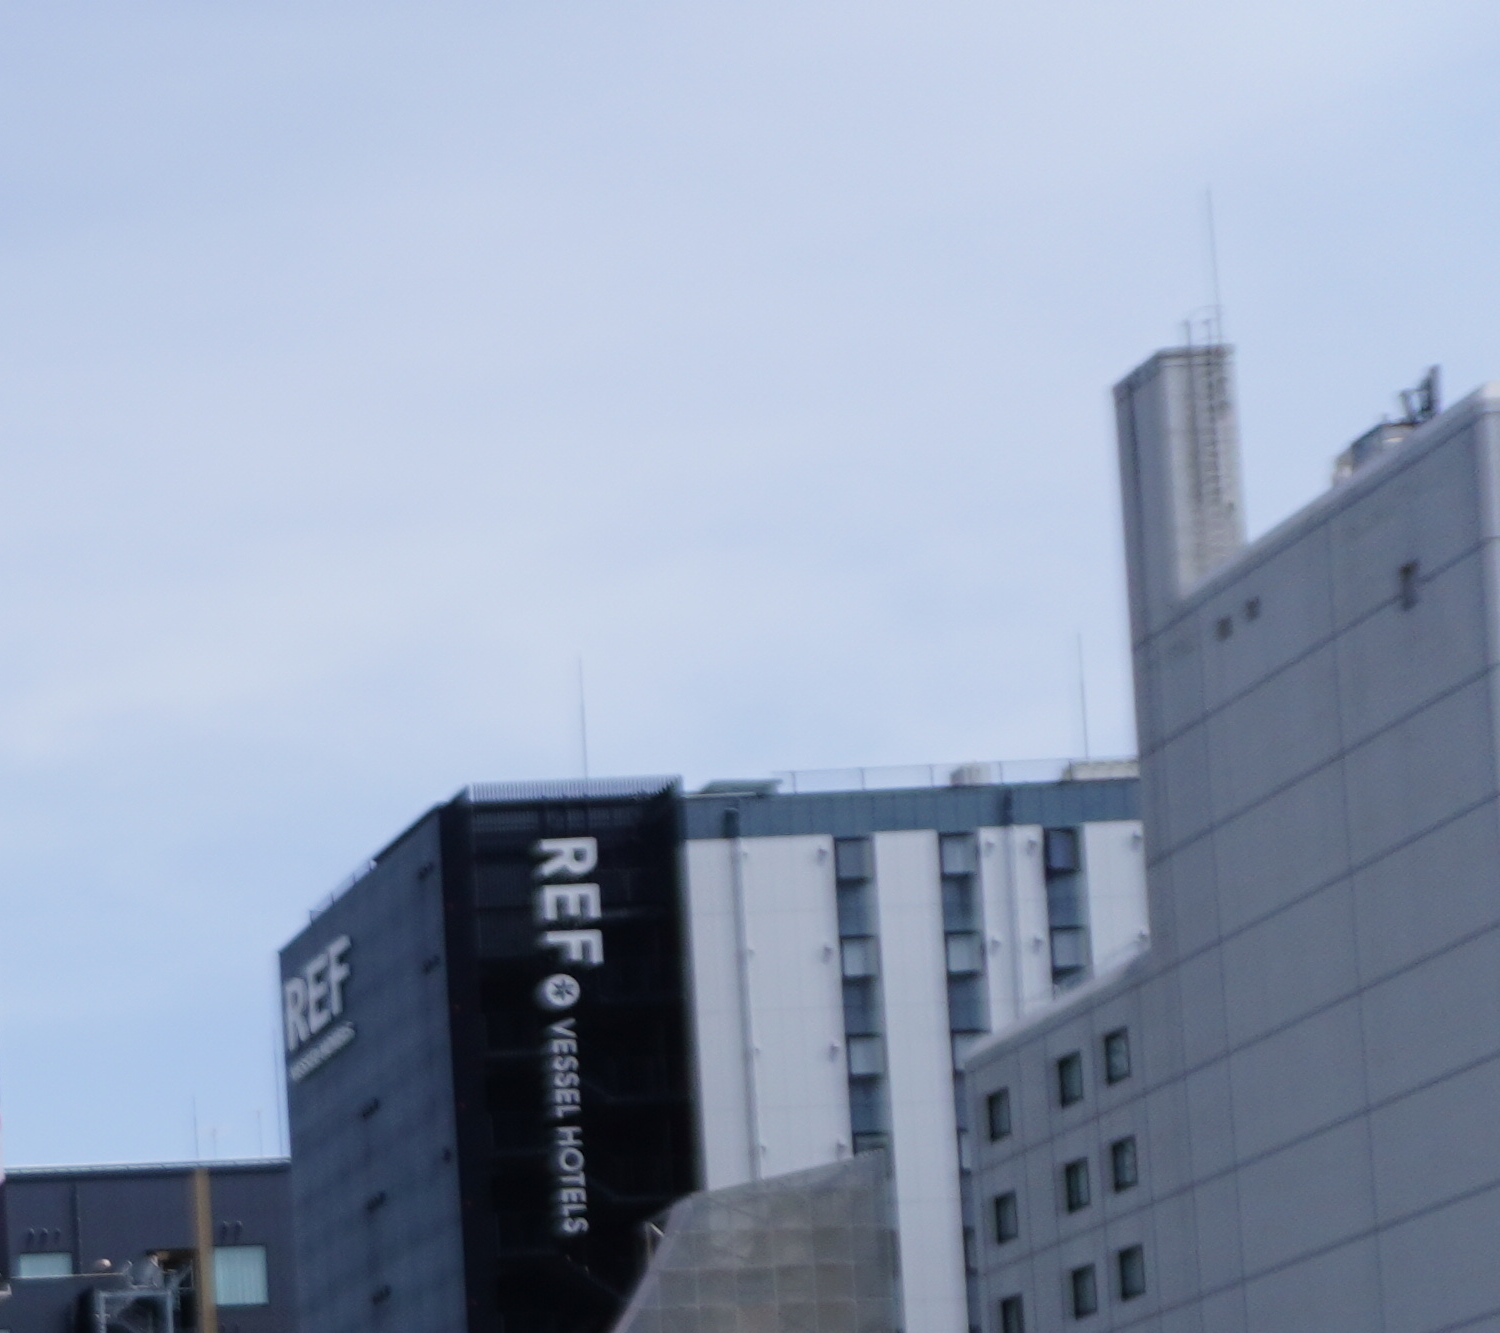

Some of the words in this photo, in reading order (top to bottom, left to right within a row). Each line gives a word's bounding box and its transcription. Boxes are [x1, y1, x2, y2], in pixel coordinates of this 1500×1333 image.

[537, 836, 604, 966] REF
[284, 934, 351, 1051] REF
[551, 1018, 579, 1118] VESSEL
[556, 1127, 590, 1236] HOTELS
